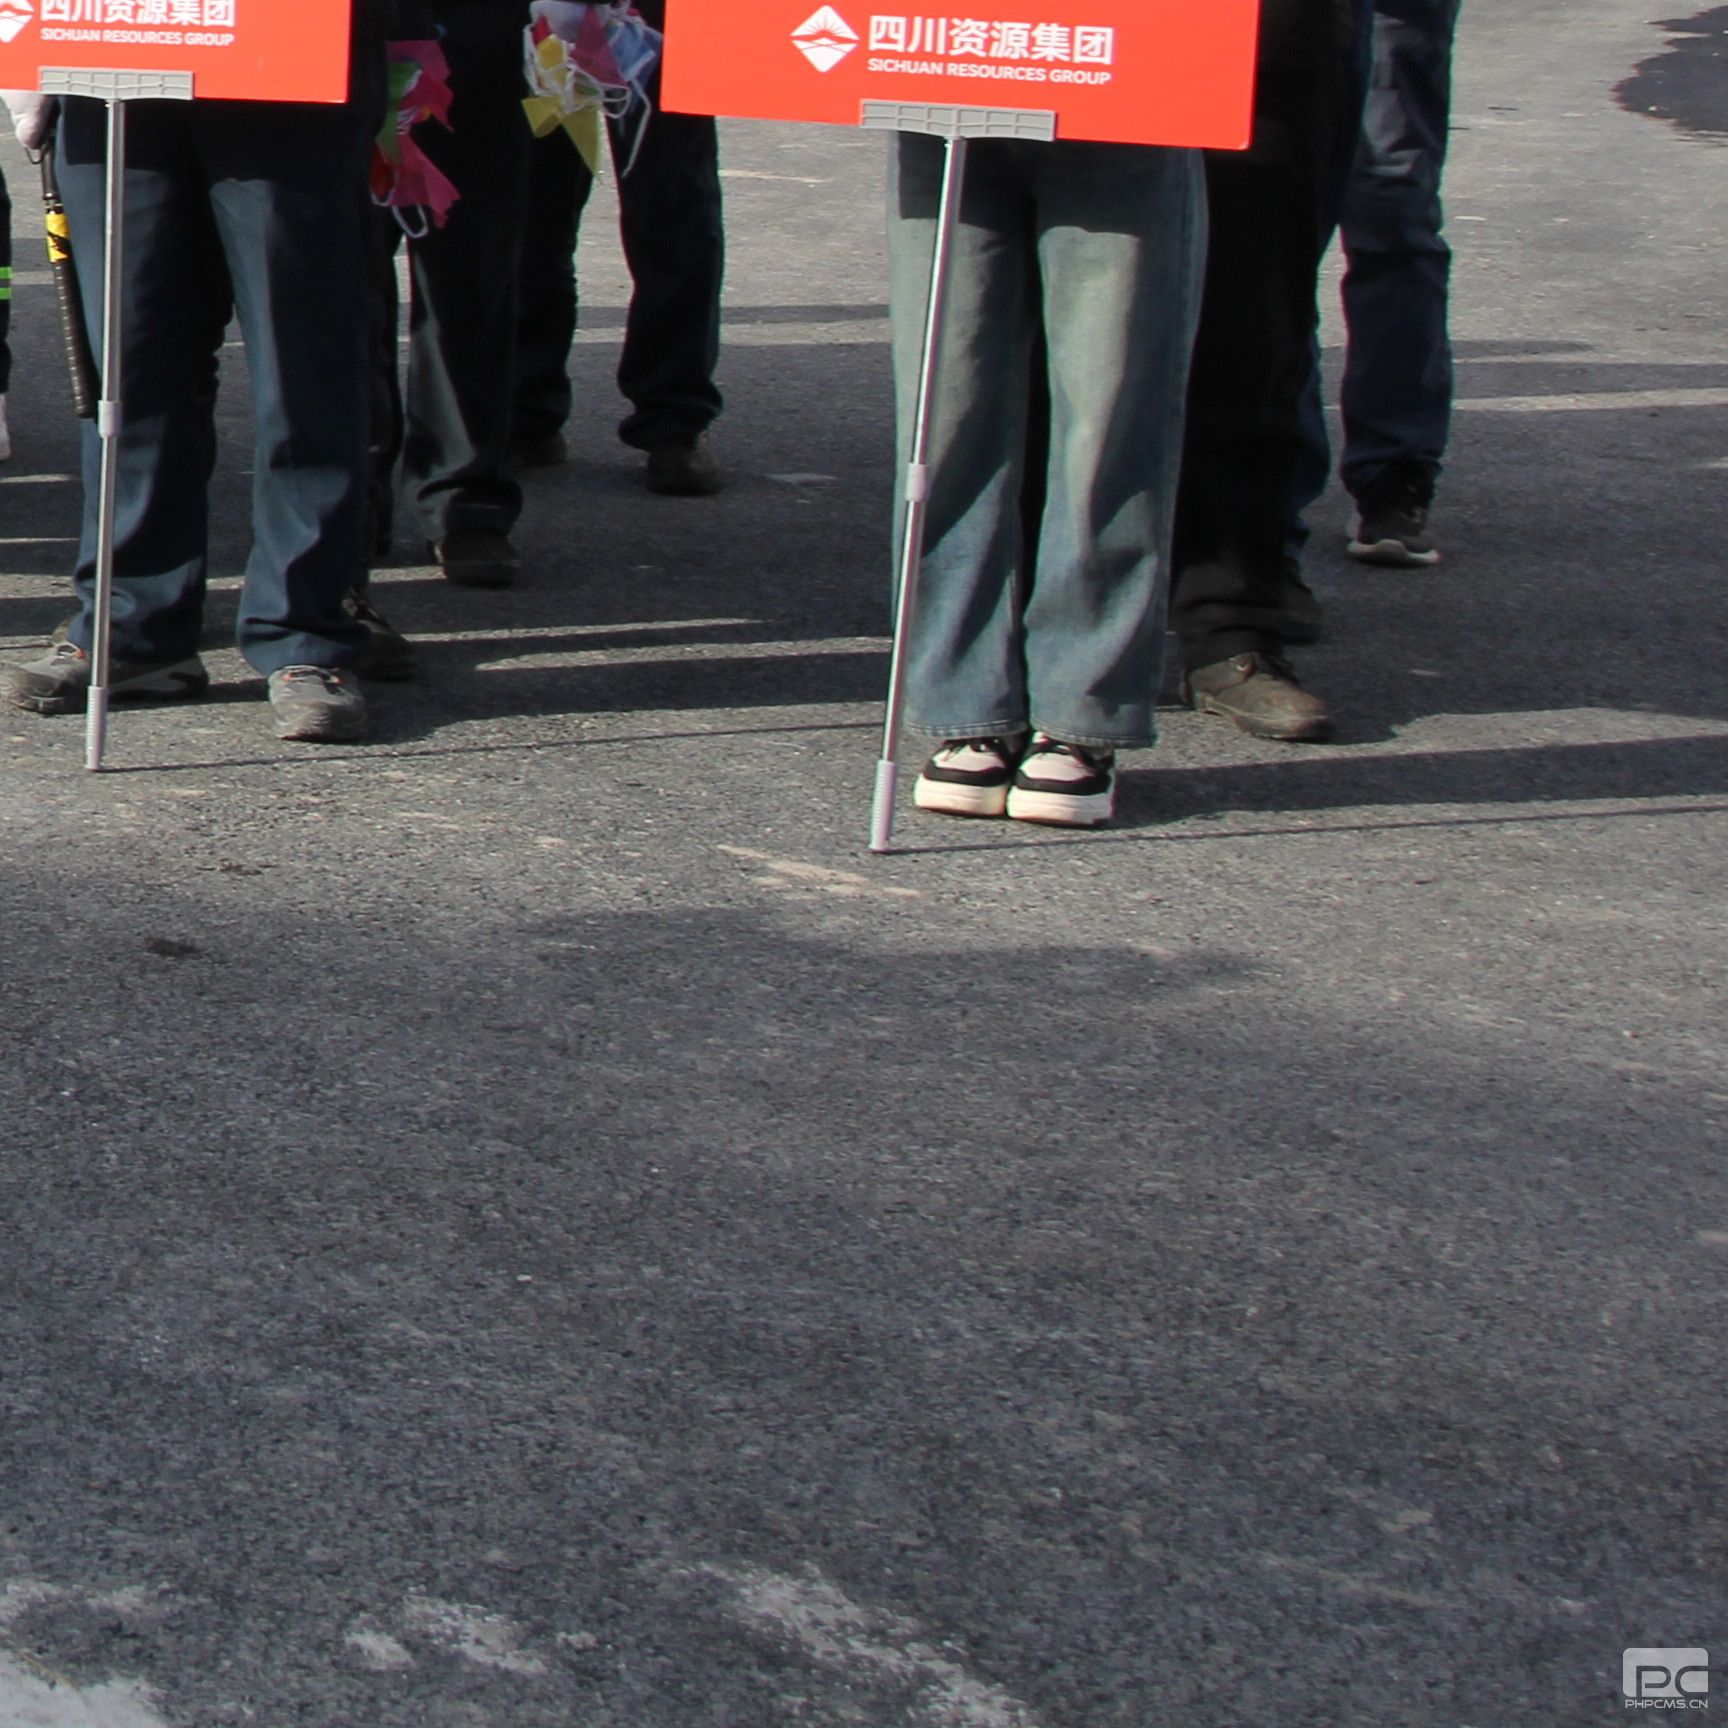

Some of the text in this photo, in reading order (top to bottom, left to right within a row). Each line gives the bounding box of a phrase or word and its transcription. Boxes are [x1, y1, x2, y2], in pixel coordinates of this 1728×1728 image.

[40, 27, 235, 47] SICHUAN RESOURCES GROUP
[868, 15, 1114, 65] 四川资源集团
[868, 57, 1111, 86] SICHUAN RESOURCES GROUP
